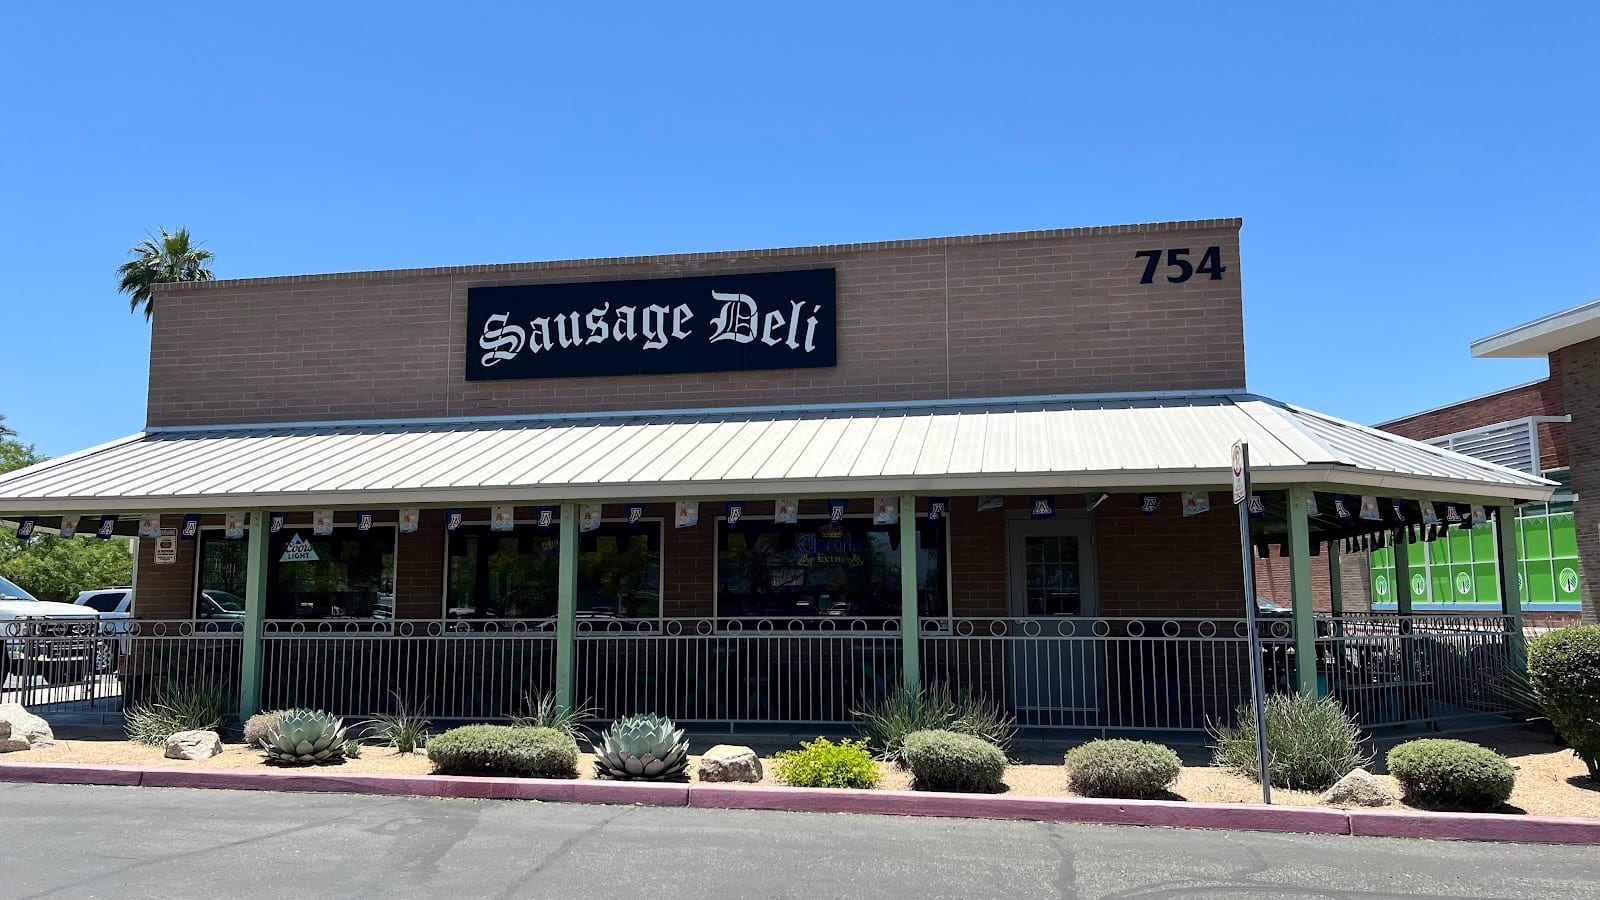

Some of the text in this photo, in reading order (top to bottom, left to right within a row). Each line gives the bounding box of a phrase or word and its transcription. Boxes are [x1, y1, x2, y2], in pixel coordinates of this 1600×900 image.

[1134, 245, 1227, 284] 754
[478, 289, 822, 367] Sausage Deli
[287, 552, 310, 560] LIGHT
